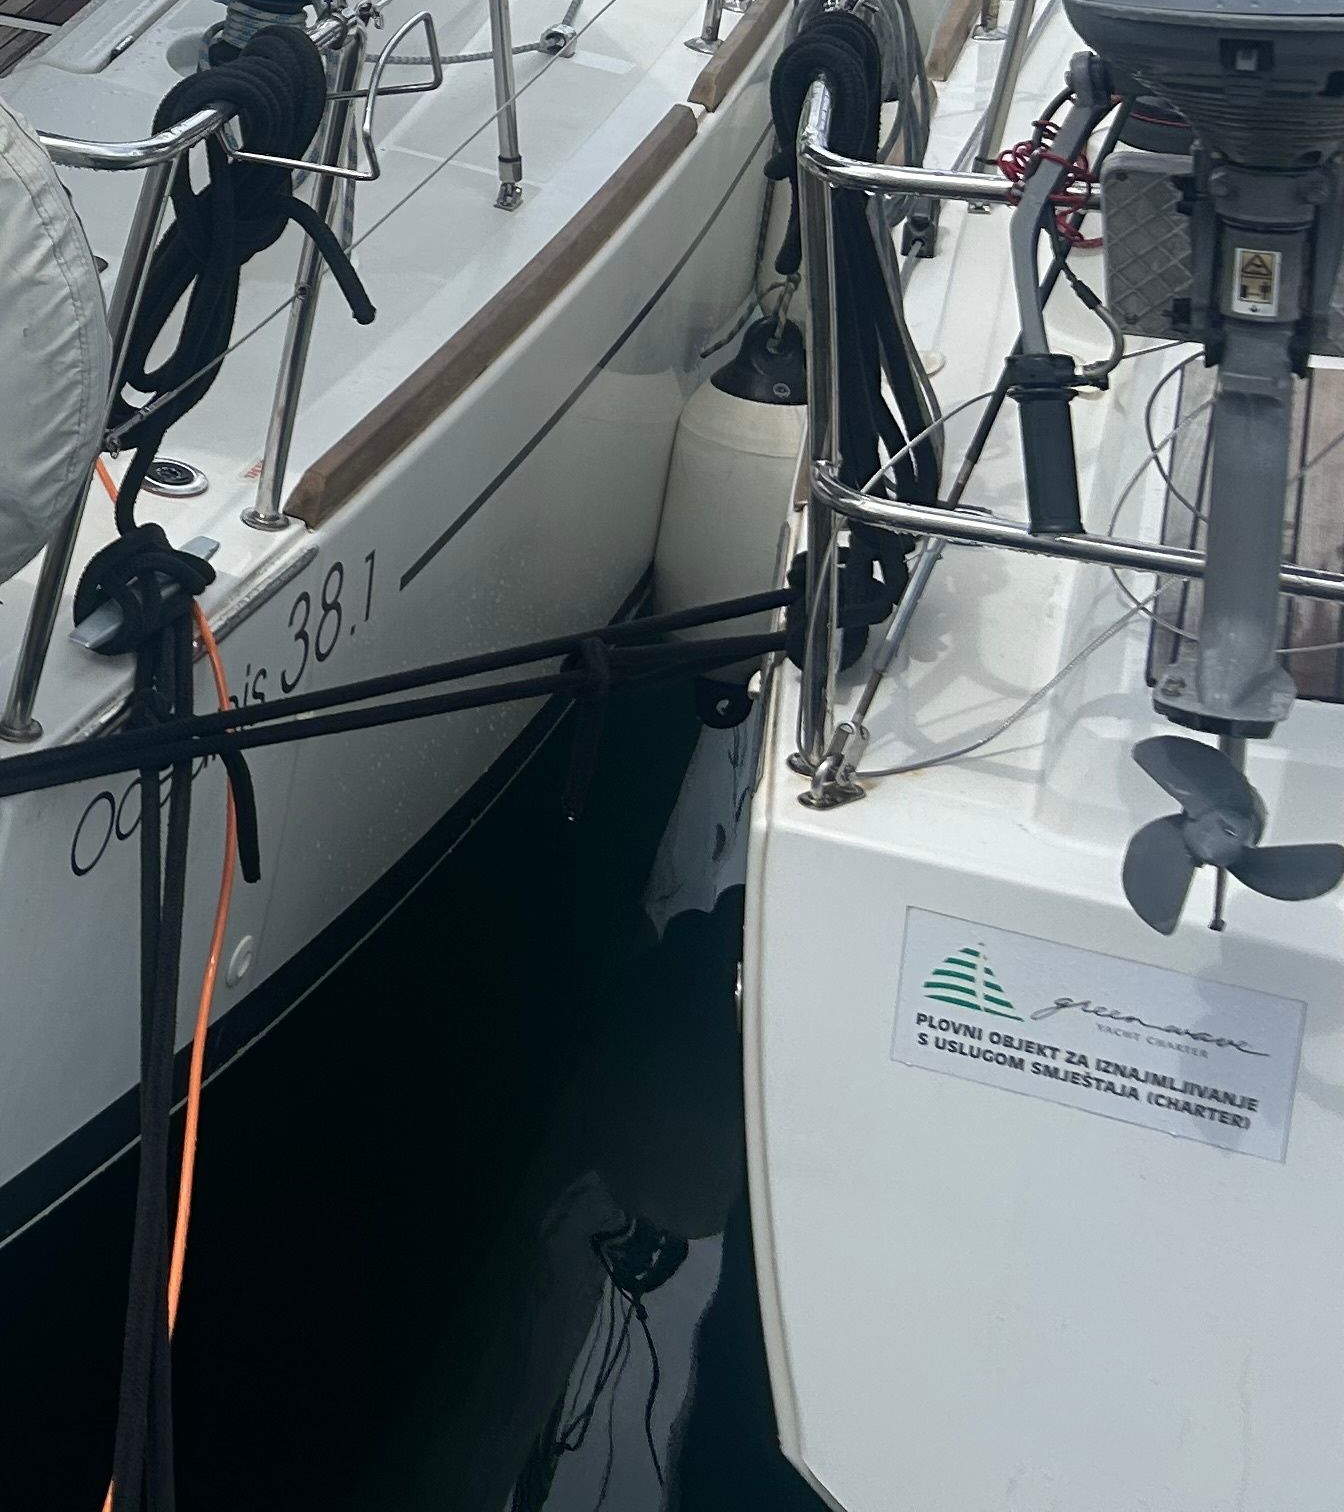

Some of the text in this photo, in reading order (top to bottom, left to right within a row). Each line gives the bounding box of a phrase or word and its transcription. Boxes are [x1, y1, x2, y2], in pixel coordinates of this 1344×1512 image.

[280, 548, 376, 695] 38.1
[916, 1012, 984, 1042] PLOVNI
[988, 1031, 1060, 1061] OBJEKT
[1065, 1050, 1089, 1069] ZA
[917, 1032, 929, 1046] S
[934, 1036, 1026, 1072] USLUGOM
[1030, 1061, 1141, 1102] SMJEŠTAJA
[1146, 1036, 1210, 1060] CHARTER
